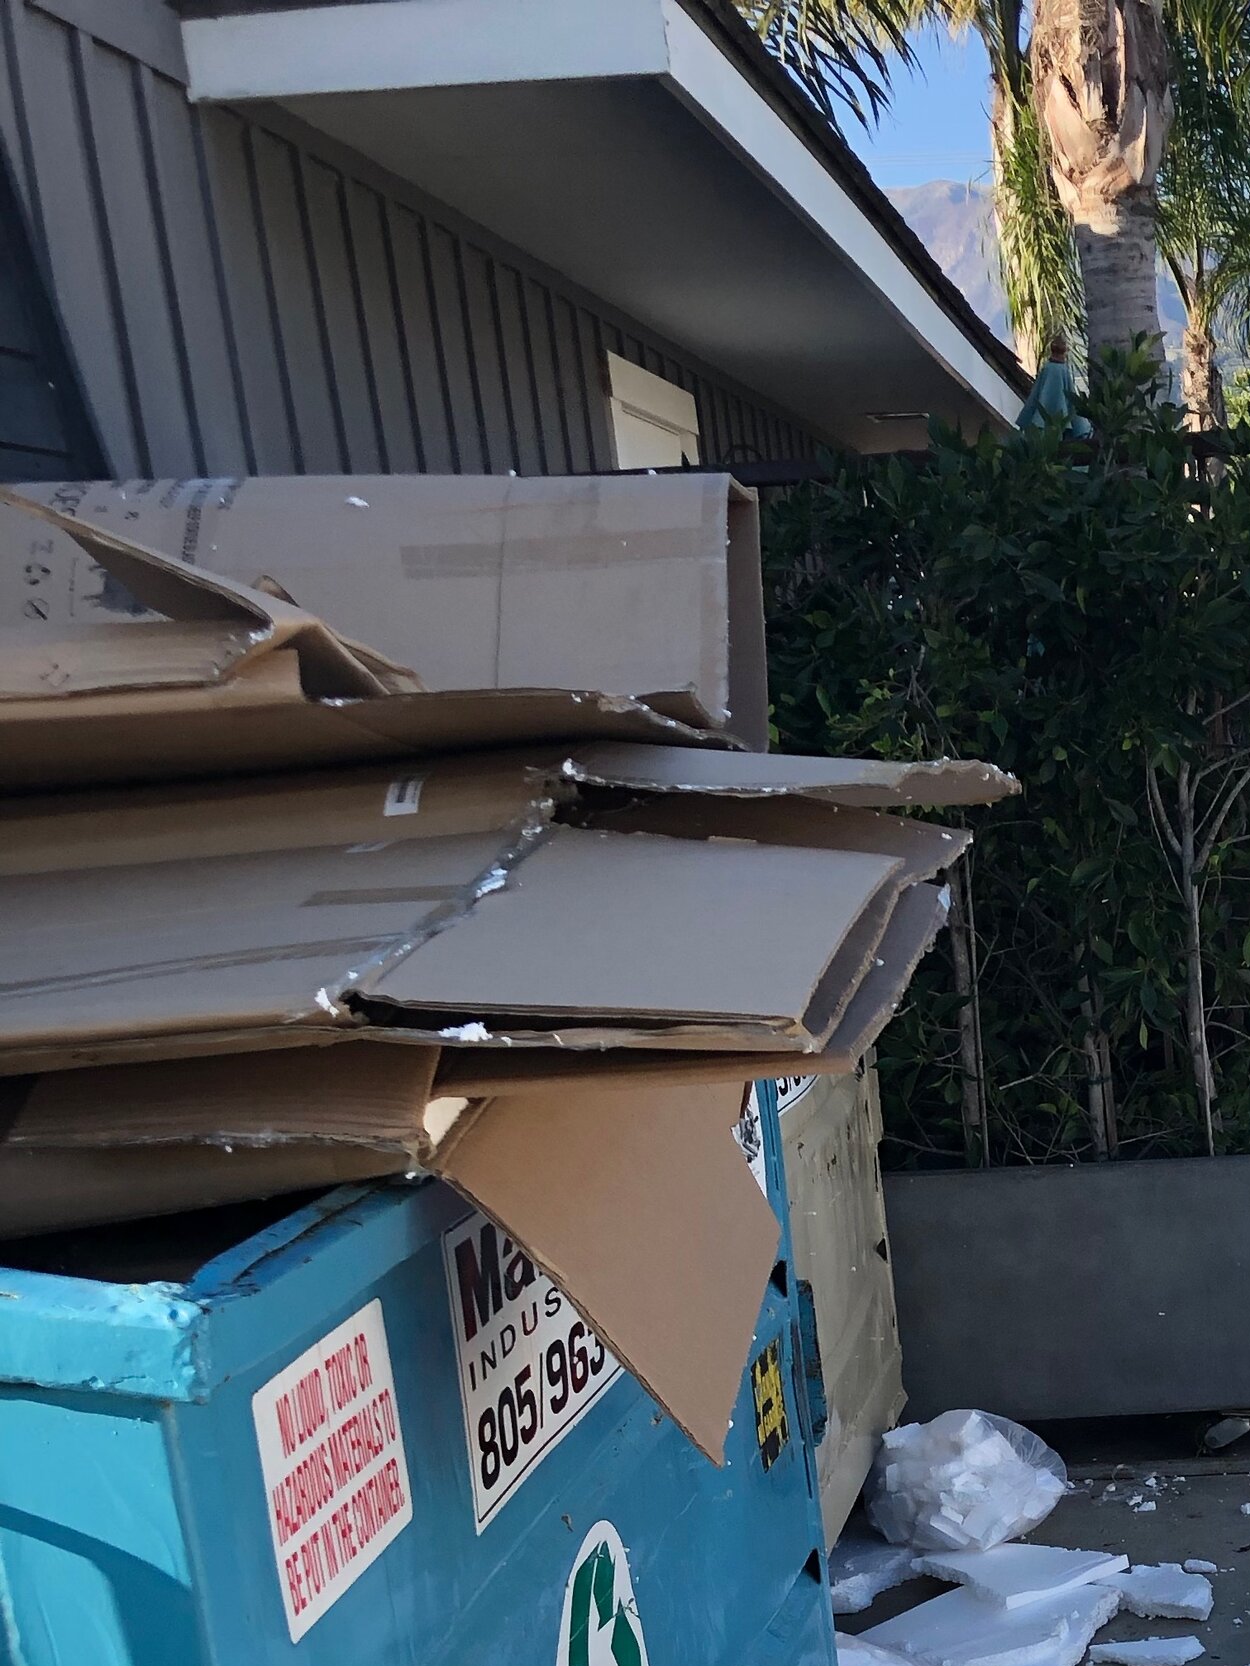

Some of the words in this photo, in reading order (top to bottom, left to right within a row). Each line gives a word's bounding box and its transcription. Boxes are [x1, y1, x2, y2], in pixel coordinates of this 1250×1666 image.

[455, 1223, 542, 1342] Ma
[275, 1393, 295, 1459] NO
[324, 1342, 357, 1414] TOXIC
[354, 1332, 373, 1392] OR
[272, 1442, 334, 1546] HAZARDOUS
[328, 1398, 384, 1492] MATERIALS
[379, 1388, 397, 1446] TO
[285, 1551, 307, 1617] BE
[301, 1533, 326, 1602] PUT
[321, 1519, 338, 1581] IN
[332, 1502, 357, 1569] THE
